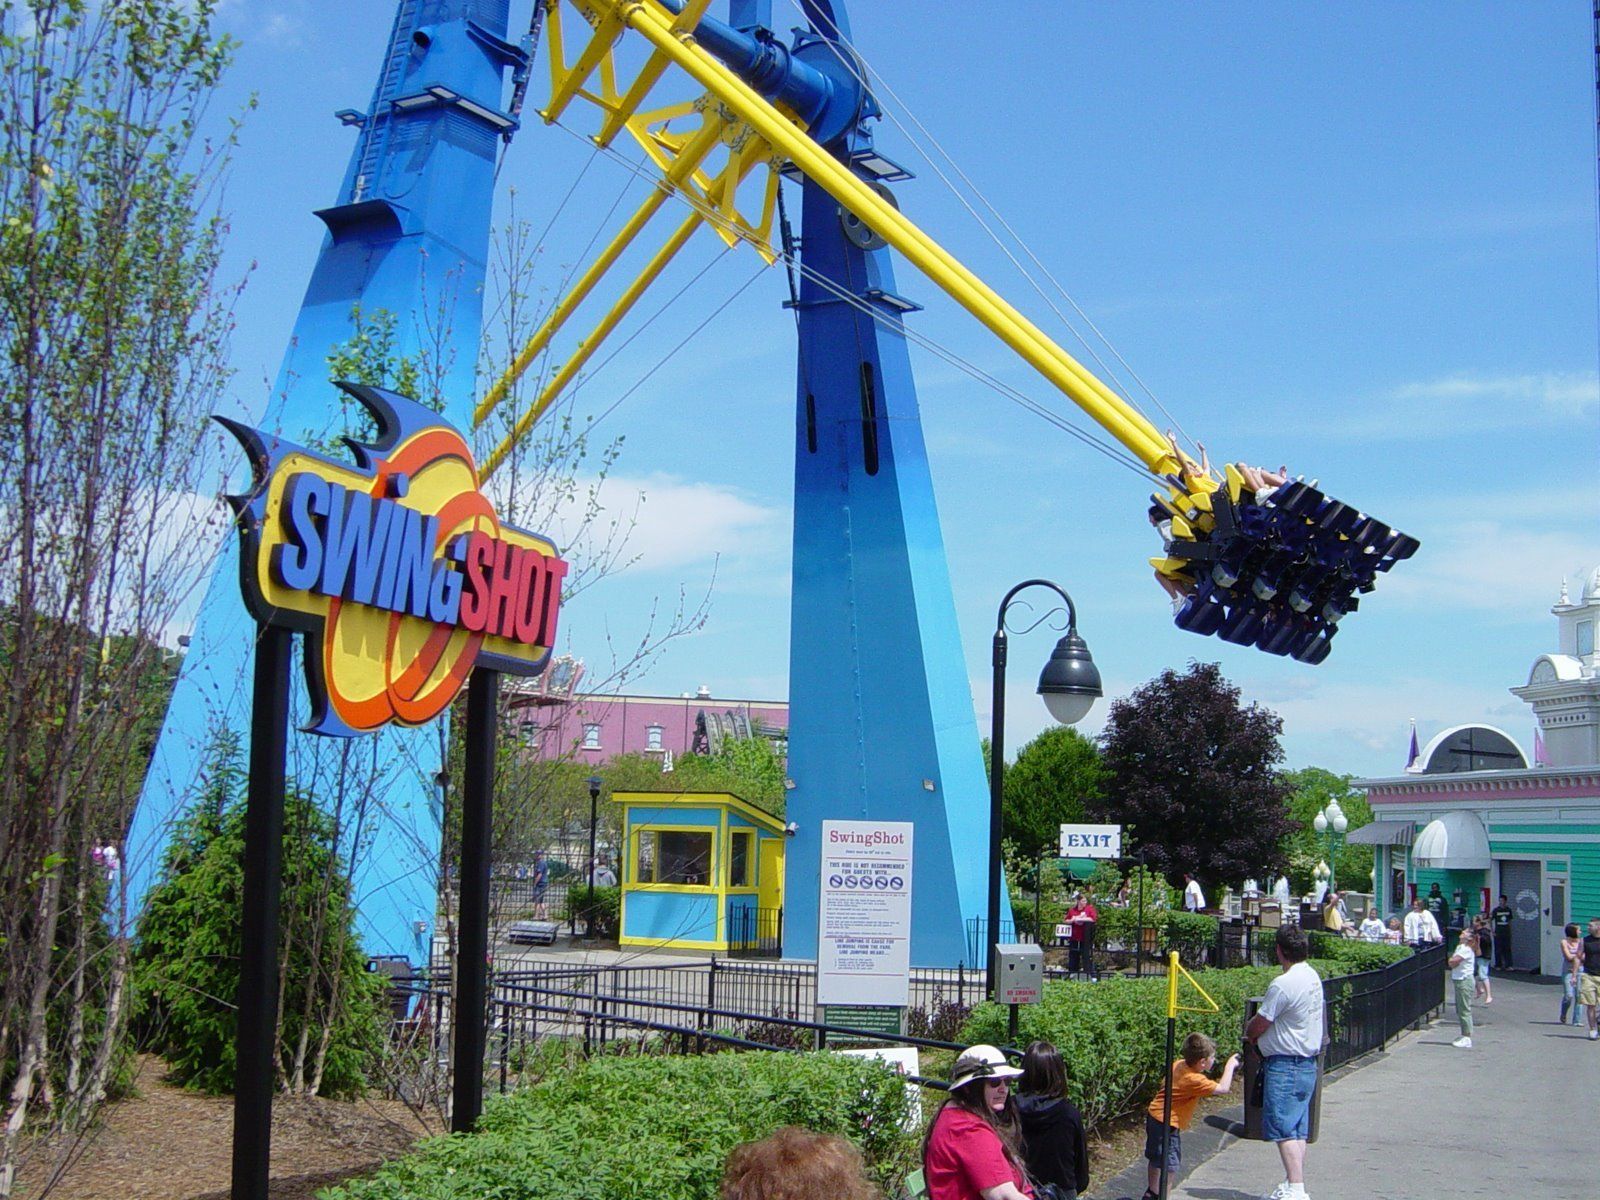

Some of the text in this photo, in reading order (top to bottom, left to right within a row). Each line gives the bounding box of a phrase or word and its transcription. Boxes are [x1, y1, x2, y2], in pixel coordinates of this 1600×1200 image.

[830, 830, 904, 847] SwingShot
[1067, 834, 1112, 848] EXIT
[1056, 926, 1071, 935] EXIT
